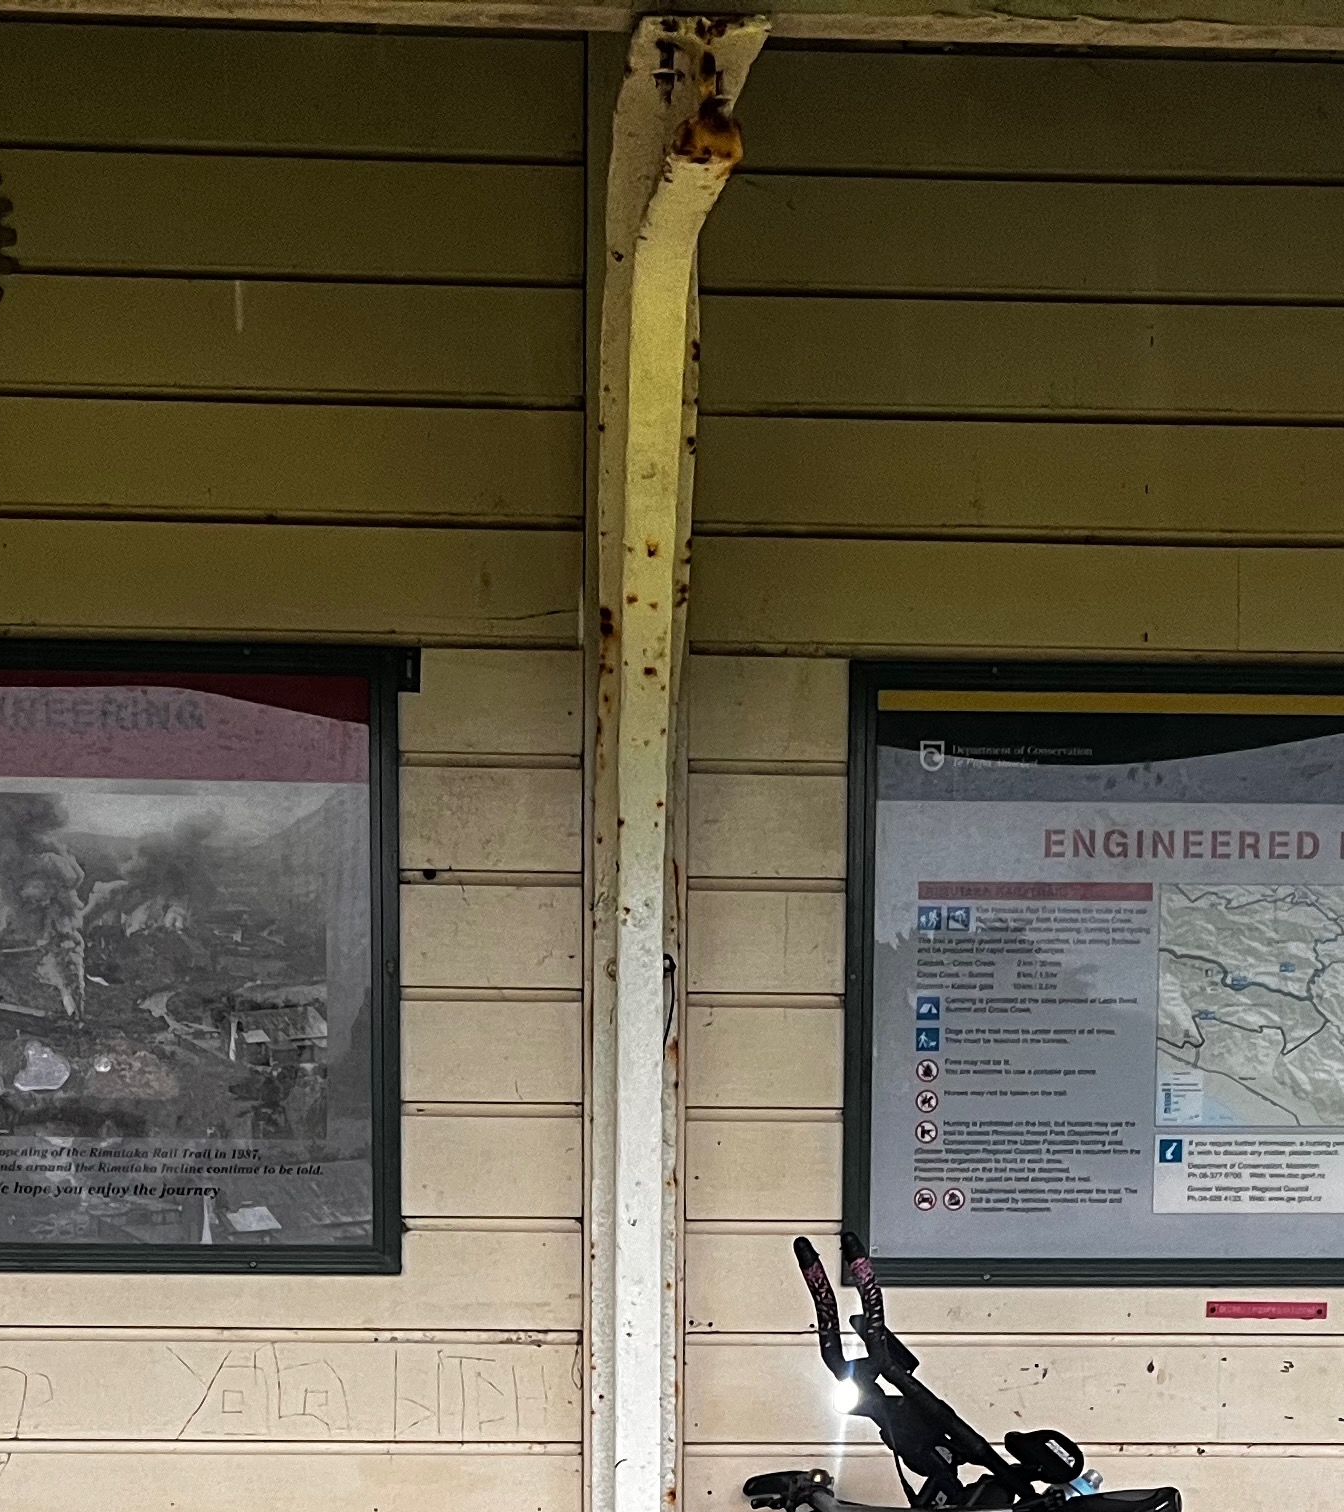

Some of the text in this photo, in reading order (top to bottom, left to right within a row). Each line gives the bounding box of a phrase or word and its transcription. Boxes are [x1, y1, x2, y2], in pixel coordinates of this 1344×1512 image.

[1043, 828, 1321, 860] ENGINEERED
[89, 1148, 148, 1159] Rimutaka
[152, 1147, 177, 1159] Rail
[182, 1149, 211, 1160] Trail
[215, 1149, 227, 1160] in
[231, 1149, 261, 1162] 1987,
[25, 1162, 72, 1173] around
[98, 1161, 156, 1174] Rimutaka
[160, 1163, 203, 1174] Incline
[206, 1164, 259, 1175] continue
[263, 1164, 276, 1175] to
[279, 1164, 293, 1175] be
[296, 1164, 324, 1176] told.
[14, 1181, 51, 1198] hope
[54, 1184, 83, 1198] you
[88, 1182, 130, 1199] enjoy
[133, 1183, 156, 1196] the
[159, 1183, 221, 1200] journey
